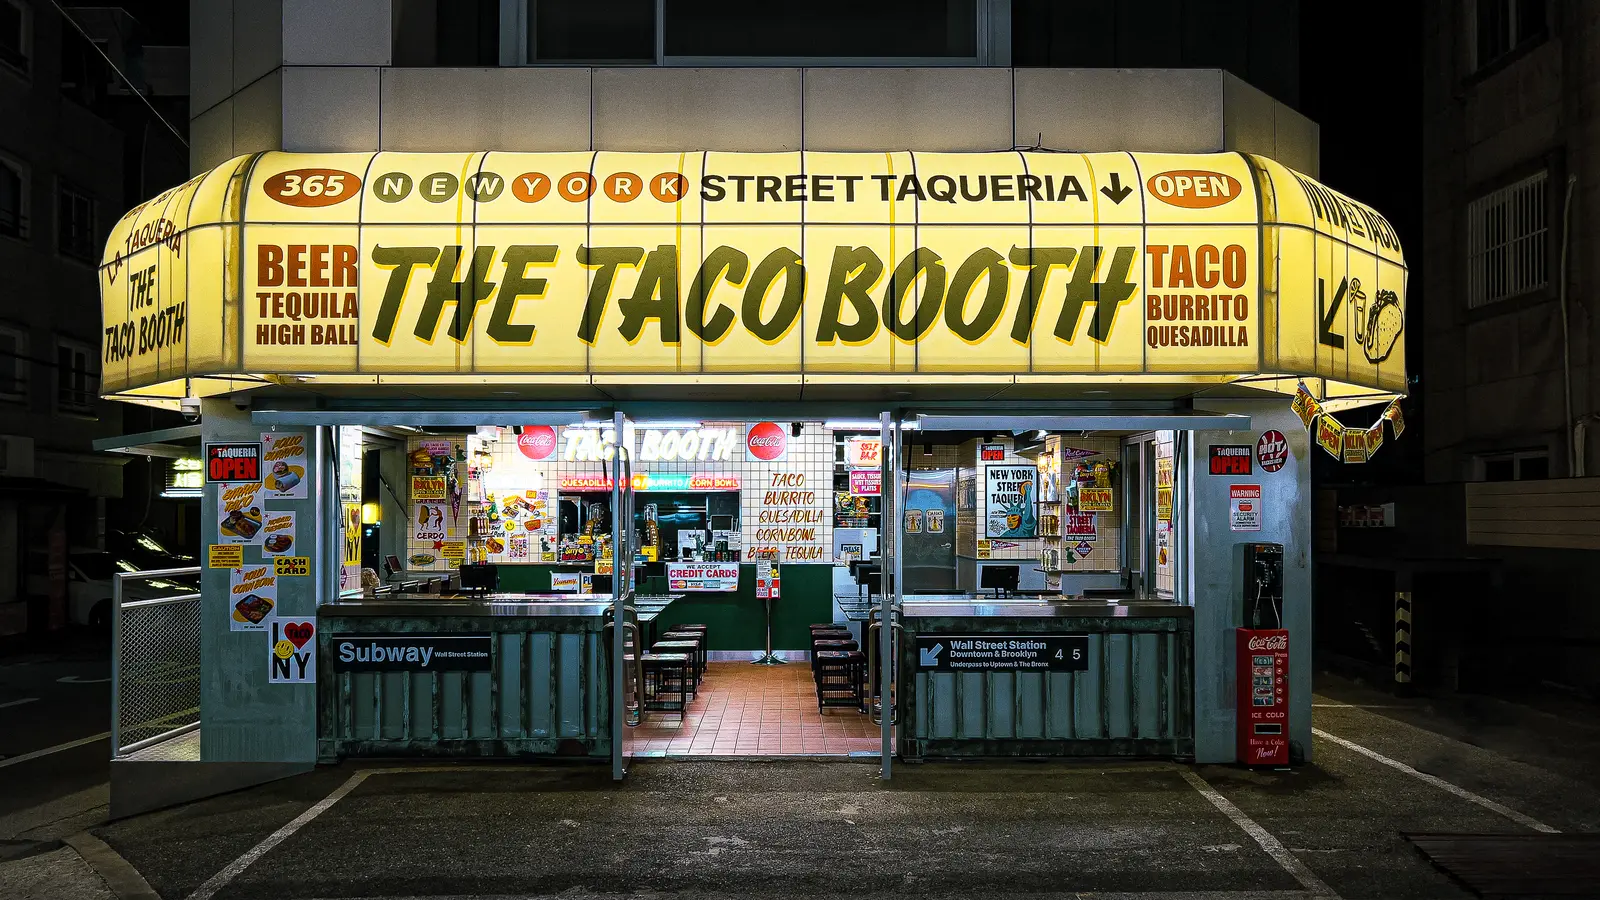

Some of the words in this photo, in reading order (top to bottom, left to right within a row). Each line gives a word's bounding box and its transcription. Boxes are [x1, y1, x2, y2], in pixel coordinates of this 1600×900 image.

[280, 175, 345, 197] 365
[700, 174, 864, 202] STREET
[870, 174, 1088, 204] TAQUERIA
[1157, 174, 1231, 198] OPEN
[107, 250, 123, 286] LA
[125, 217, 182, 259] TAQUERIA
[257, 244, 358, 287] BEER
[1146, 244, 1247, 289] TACO
[129, 264, 157, 312] THE
[372, 243, 559, 346] THE
[576, 243, 808, 347] TACO
[816, 243, 1137, 347] BOOTH
[256, 292, 358, 321] TEQUILA
[1147, 294, 1248, 321] BURRITO
[105, 320, 136, 364] TACO
[138, 301, 185, 356] BOOTH
[256, 324, 305, 345] HIGH
[310, 324, 358, 345] BALL
[1147, 325, 1249, 348] QUESADILLA
[217, 447, 257, 458] TAQUERIA
[640, 428, 738, 461] BOOTH
[1217, 447, 1250, 456] TAQUERIA
[982, 450, 1003, 460] OPEN
[210, 457, 257, 479] OPEN
[1211, 456, 1250, 474] OPEN
[561, 479, 613, 488] QUESADILLA
[690, 479, 711, 488] CORN
[714, 479, 738, 488] BOWL
[771, 473, 804, 487] TACO
[990, 469, 1009, 480] NEW
[1011, 469, 1033, 480] YORK
[763, 491, 815, 506] BURRITO
[1231, 489, 1260, 498] WARNING
[759, 509, 824, 524] QUESADILLA
[416, 532, 444, 540] CERDO
[785, 546, 823, 560] TEQUILA
[670, 569, 704, 578] CREDIT
[706, 569, 738, 578] CARDS
[272, 622, 278, 649] I
[290, 630, 311, 640] TACO
[1248, 634, 1288, 650] Coca-Cola
[950, 640, 974, 650] Wall
[975, 640, 1007, 650] Street
[1008, 640, 1047, 650] Station
[1055, 648, 1064, 660] 4
[1072, 648, 1082, 660] 5
[339, 642, 434, 667] Subway
[950, 650, 993, 658] Downtown
[994, 650, 1000, 658] &
[1001, 650, 1037, 659] Brooklyn
[272, 653, 311, 679] NY
[1255, 746, 1279, 760] Now!
